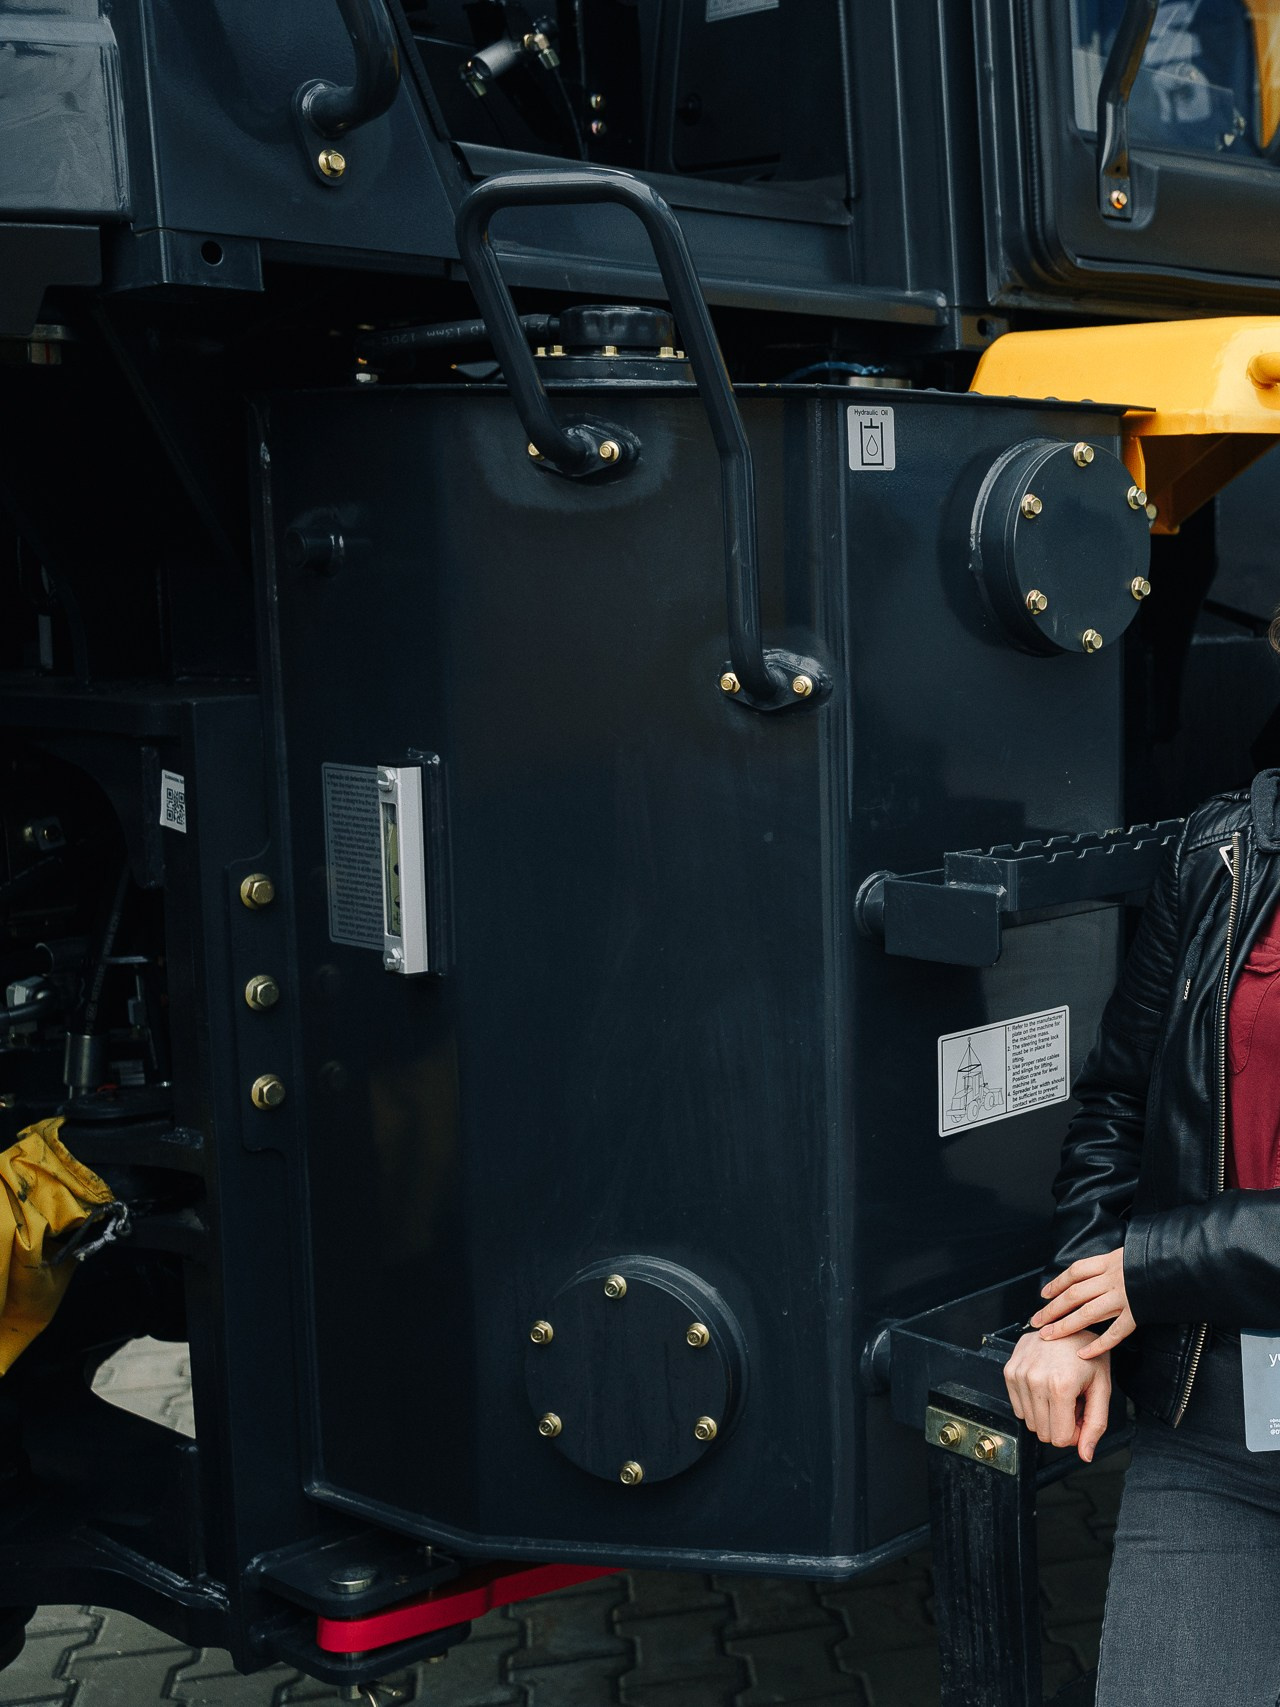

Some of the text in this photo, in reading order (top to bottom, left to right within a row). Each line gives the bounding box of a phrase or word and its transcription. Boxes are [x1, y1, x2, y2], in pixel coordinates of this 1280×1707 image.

[1037, 1015, 1063, 1024] manufacturer
[1021, 1040, 1037, 1048] steering
[1012, 1081, 1030, 1089] machine
[1013, 1087, 1031, 1095] Spreader
[1019, 1091, 1037, 1100] sufficient
[1043, 1085, 1058, 1094] prevent
[1012, 1100, 1027, 1108] contact
[1038, 1093, 1055, 1101] machine.
